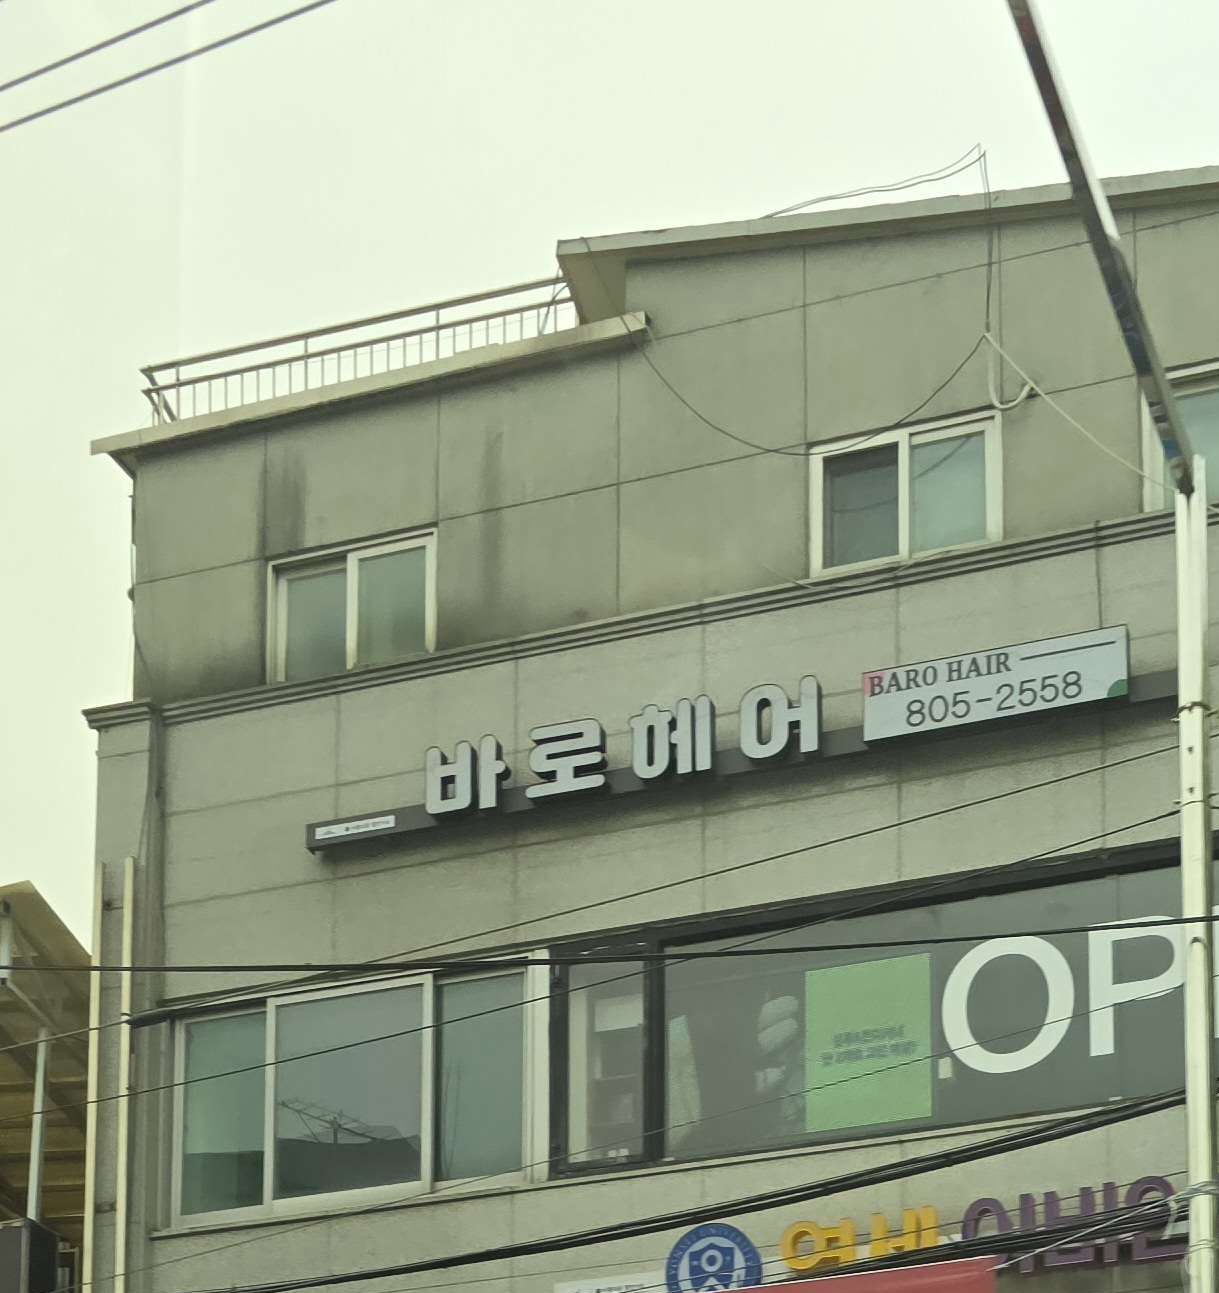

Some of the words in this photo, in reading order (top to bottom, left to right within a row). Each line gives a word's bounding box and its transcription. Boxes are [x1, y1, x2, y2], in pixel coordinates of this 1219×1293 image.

[869, 666, 938, 697] BARO
[946, 652, 1012, 683] HAIR
[906, 670, 1082, 727] 805-2558
[425, 675, 822, 815] 바로헤어
